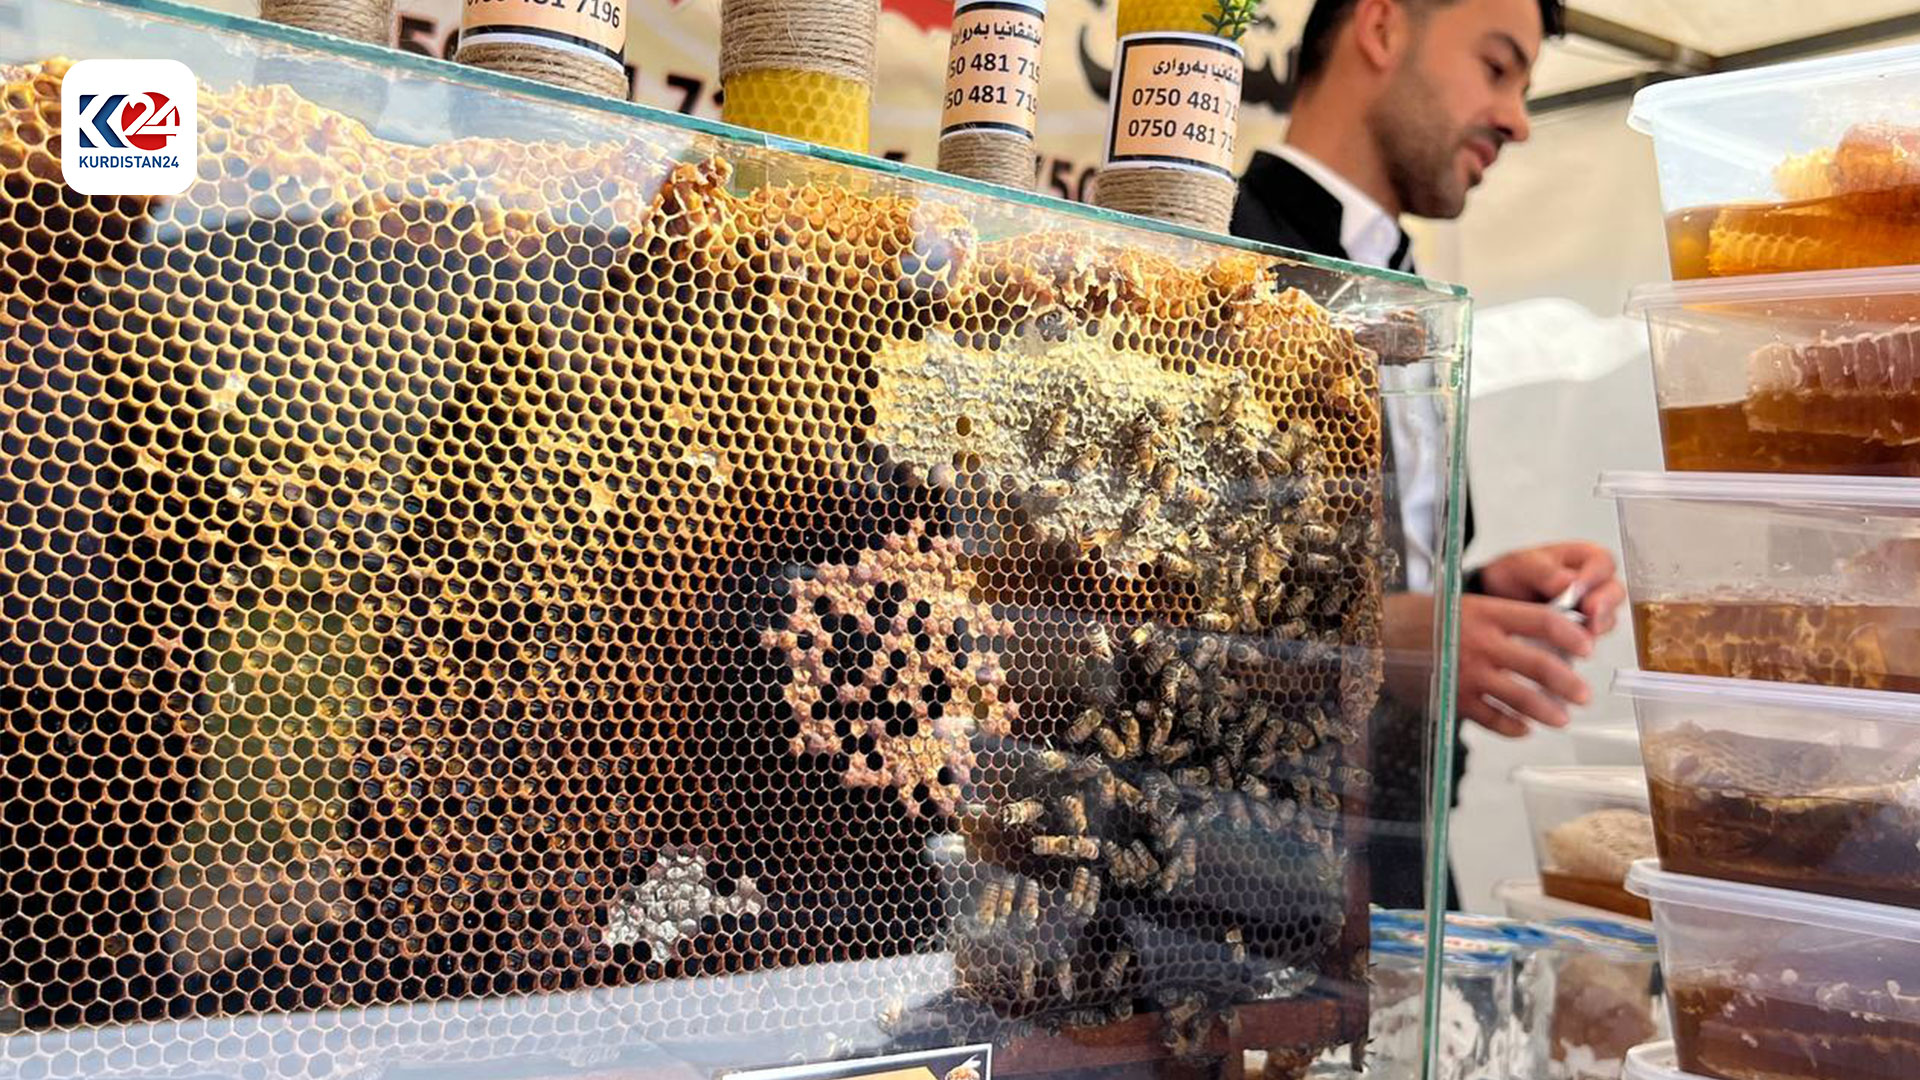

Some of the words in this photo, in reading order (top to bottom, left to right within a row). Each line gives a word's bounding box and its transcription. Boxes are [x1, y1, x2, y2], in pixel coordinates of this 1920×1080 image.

[948, 56, 966, 79] 50
[971, 53, 1010, 73] 481
[944, 88, 964, 110] 50
[968, 84, 1008, 104] 481
[1131, 88, 1181, 107] 0750
[1187, 91, 1220, 114] 481
[1128, 119, 1177, 138] 0750
[1182, 122, 1216, 146] 481
